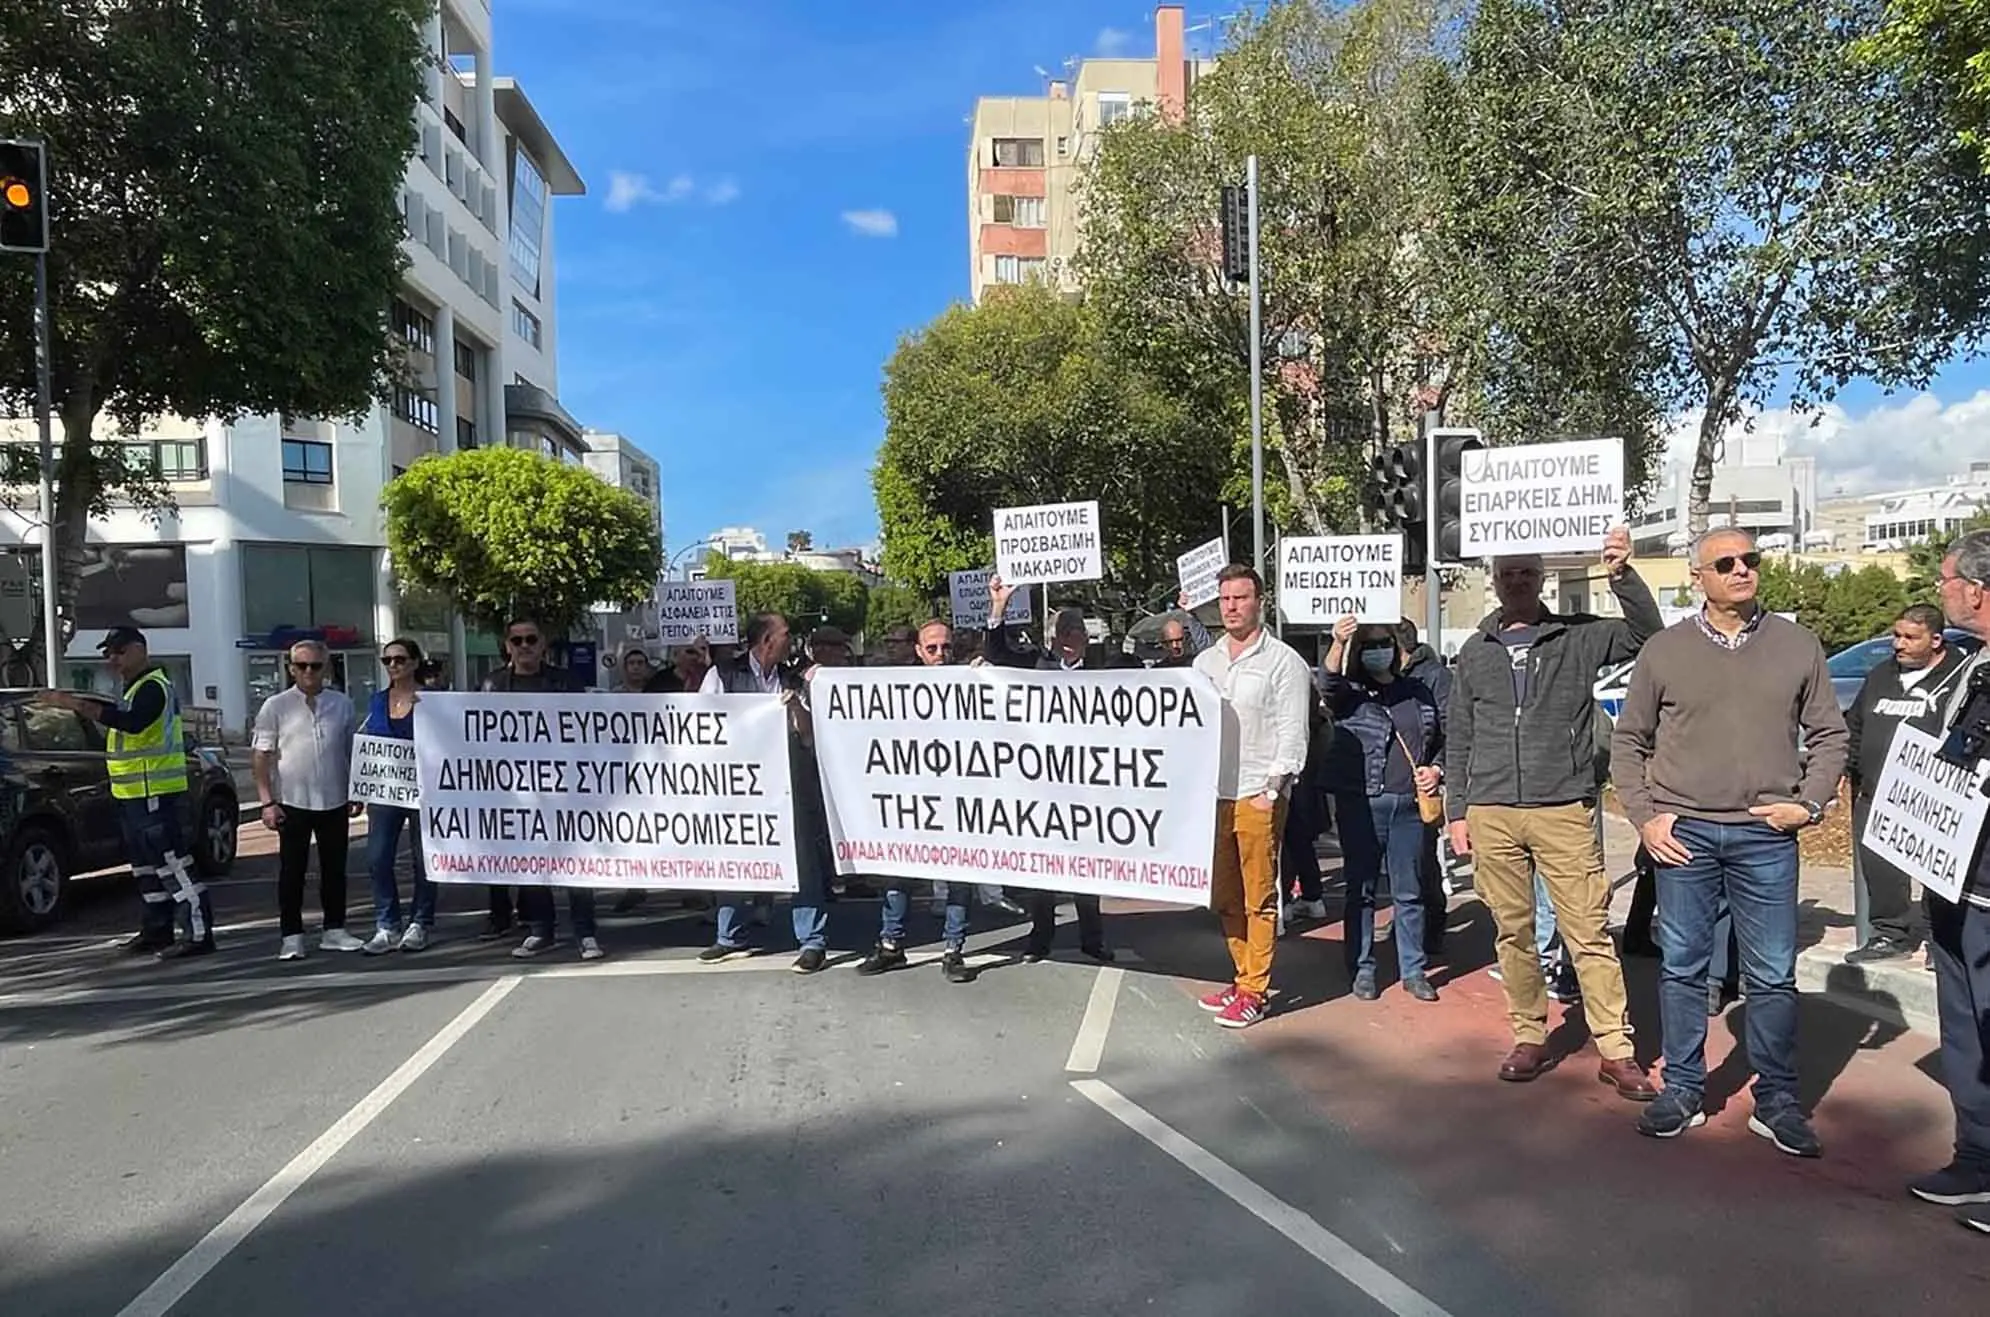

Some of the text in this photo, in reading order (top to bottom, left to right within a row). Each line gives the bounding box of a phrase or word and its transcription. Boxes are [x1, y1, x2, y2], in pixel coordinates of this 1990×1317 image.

[1483, 454, 1600, 482] ΑΠΑΙΤΟΥΜΕ
[1465, 483, 1618, 513] ΕΠΑΡΚΕΙΣ ΔΗΜ.
[1003, 508, 1089, 531] ΑΠΑΙΤΟΥΜΕ
[1469, 514, 1614, 543] ΣΥΓΚΟΙΝΟΝΙΕΣ
[1000, 531, 1095, 556] ΠΡΟΣΒΑΣΙΜΗ
[1288, 544, 1393, 563] ΑΠΑΙΤΟΥΜΕ
[958, 573, 989, 585] ΑΠΑΙΤ
[1011, 557, 1087, 578] ΜΑΚΑΡΙΟΥ
[1285, 570, 1395, 589] ΜΕΙΩΣΗ ΤΩΝ
[666, 587, 725, 601] ΑΠΑΙΤΟΥΜΕ
[1311, 596, 1366, 614] ΡΙΠΩΝ
[661, 605, 734, 619] ΑΣΦΑΛΕΙΑ ΣΤΙΣ
[828, 683, 1204, 728] ΑΠΑΙΤΟΥΜΕ ΕΠΑΝΑΦΟΡΑ
[464, 705, 728, 746] ΠΡΩΤΑ ΕΥΡΩΠΑΪΚΕΣ
[359, 742, 416, 760] ΑΠΑΙΤΟΥΜ
[865, 738, 1168, 789] ΑΜΦΙΔΡΟΜΙΣΗΣ
[360, 762, 417, 781] ΔΙΑΚΙΝΗΣ
[438, 758, 763, 796] ΔΗΜΟΣΙΕΣ ΣΥΓΚΥΝΩΝΙΕΣ
[1896, 740, 1980, 800] ΑΠΑΙΤΟΥΜΕ
[353, 781, 420, 802] ΧΩΡΙΣ ΝΕΥΡ
[871, 793, 1164, 848] ΤΗΣ ΜΑΚΑΡΙΟΥ
[1887, 778, 1964, 839] ΔΙΑΚΙΝΗΣΗ
[429, 807, 781, 846] ΚΑΙ ΜΕΤΑ ΜΟΝΟΔΡΟΜΙΣΕΙΣ
[1869, 809, 1958, 886] ΜΕ ΑΣΦΑΛΕΙΑ
[432, 853, 783, 881] ΟΜΑΔΑ ΚΥΚΛΟΦΟΡΙΑΚΟ ΧΑΟΣ ΣΤΗΝ ΚΕΝΤΡΙΚΗ ΛΕΥΚΩΣΙΑ
[837, 841, 1209, 890] ΟΜΑΔΑ ΚΥΚΛΟΦΟΡΙΑΚΟ ΧΑΟΣ ΣΤΗΝ ΚΕΝΤΡΙΚΗ ΛΕΥΚΩΣΙΑ
